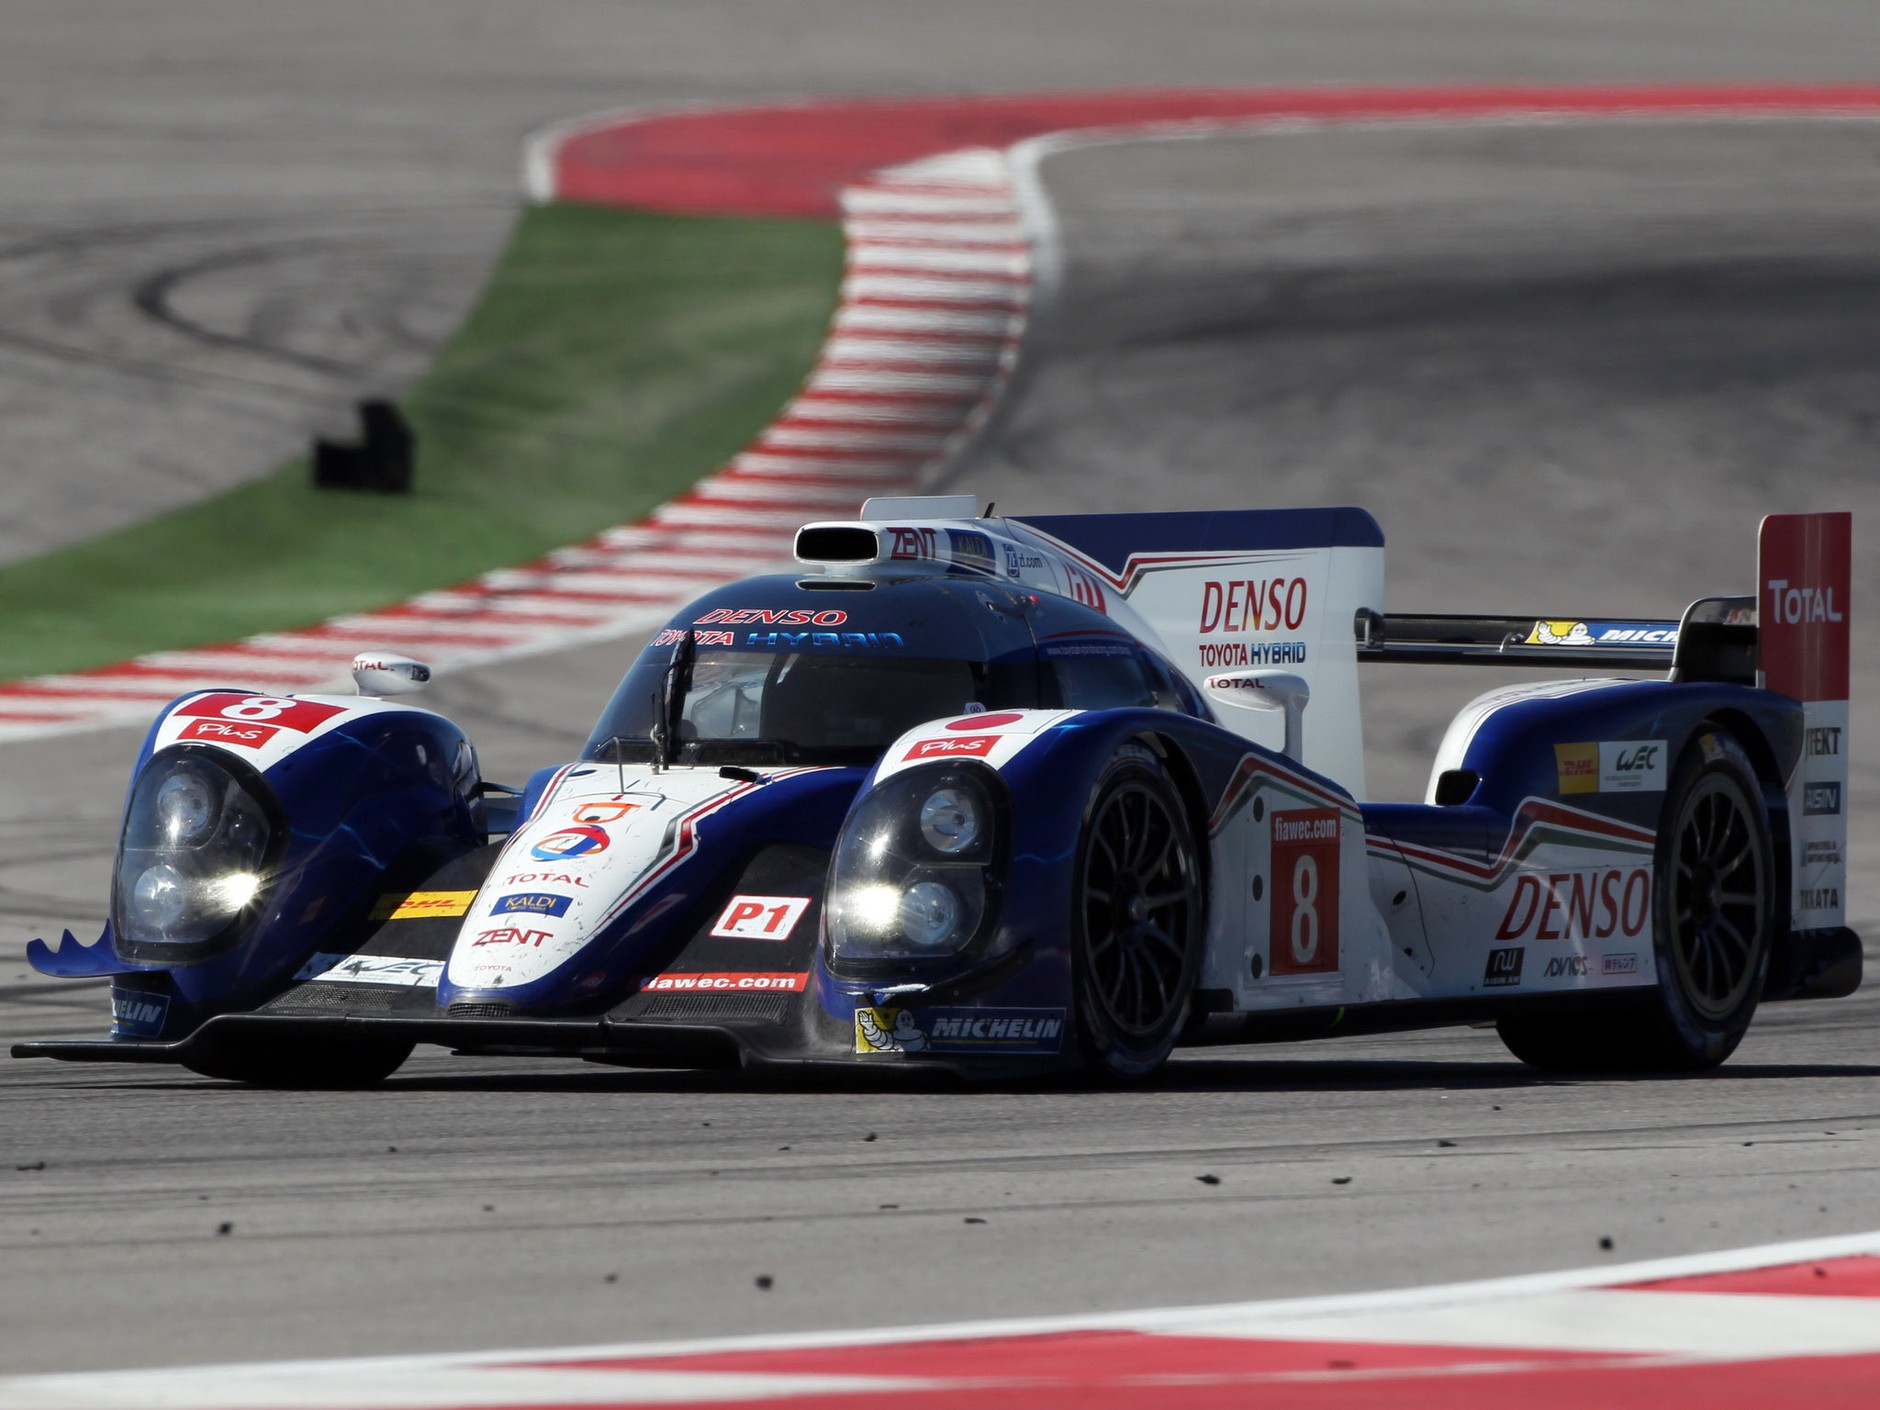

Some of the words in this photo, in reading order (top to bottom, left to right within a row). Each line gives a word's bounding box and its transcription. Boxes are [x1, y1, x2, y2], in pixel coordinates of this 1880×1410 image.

[886, 527, 937, 561] ZENT
[1200, 577, 1307, 634] DENSO
[1768, 580, 1843, 623] TOTAL
[693, 608, 848, 626] DENSO
[746, 632, 905, 649] HYBRID
[1199, 643, 1249, 667] TOYOTA
[1251, 642, 1307, 665] HYBRID
[1208, 677, 1265, 689] TOTAL
[221, 697, 296, 721] 8
[196, 723, 263, 740] Plus
[921, 737, 984, 757] Plus
[1616, 745, 1659, 772] WEC
[1805, 788, 1838, 809] AISIN
[1275, 817, 1337, 842] fiawec.com
[507, 873, 589, 888] TOTAL
[394, 899, 456, 909] DHL
[505, 896, 557, 907] KALDI
[1291, 854, 1318, 963] 8
[1494, 868, 1650, 941] DENSO
[1799, 888, 1838, 911] TAKATA
[722, 902, 789, 933] P1
[471, 928, 554, 947] ZENT
[473, 964, 512, 972] TOYOTA
[1544, 956, 1588, 977] ADVICS
[931, 1018, 1062, 1038] MICHELIN
